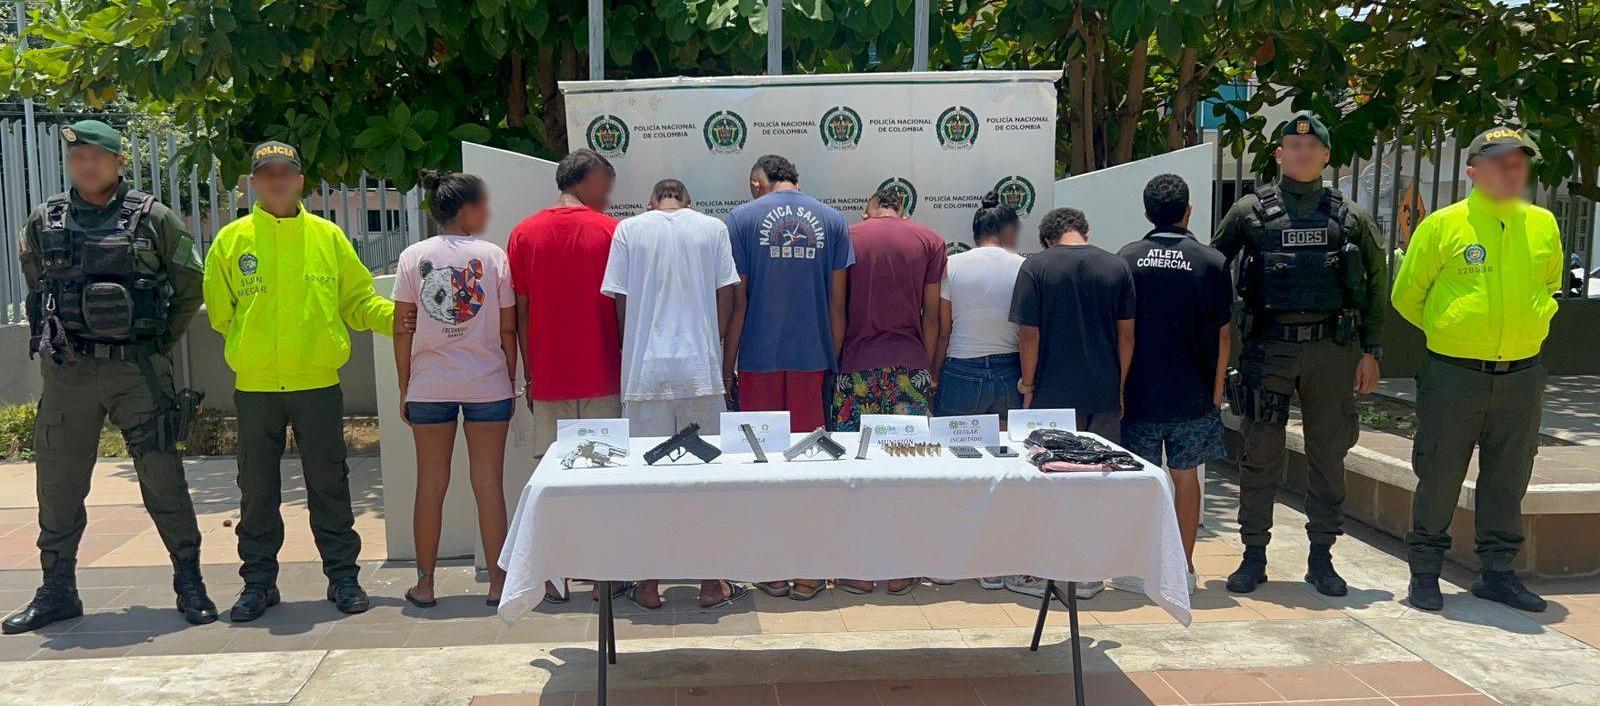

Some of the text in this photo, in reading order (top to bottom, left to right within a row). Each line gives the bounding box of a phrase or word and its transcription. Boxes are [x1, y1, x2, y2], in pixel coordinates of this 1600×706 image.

[661, 123, 697, 131] NACIONAL
[754, 120, 817, 129] POLICÍA NACIONAL
[869, 117, 895, 125] POLICÍA
[256, 146, 294, 159] POLICIA
[760, 205, 825, 249] NAUTICA SAILING
[1287, 231, 1323, 244] GOES
[1146, 248, 1184, 260] ATLETA
[1136, 258, 1193, 271] COMERCIAL
